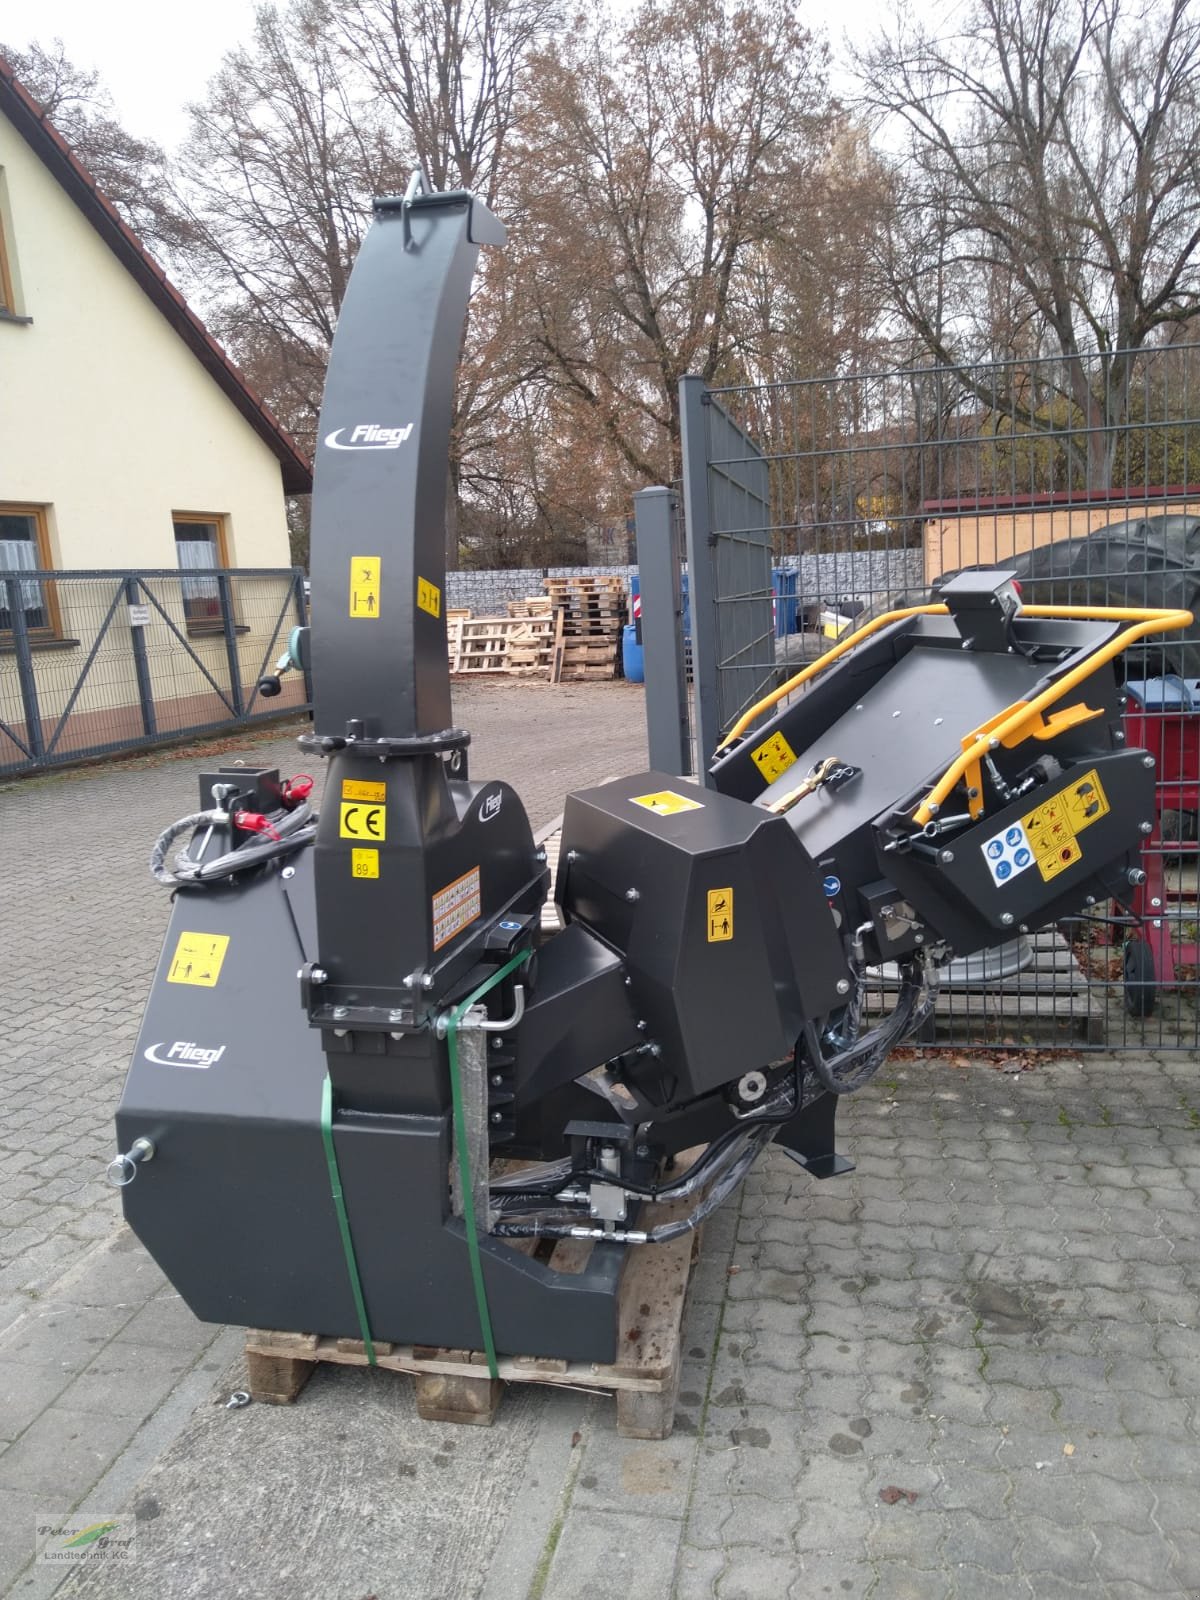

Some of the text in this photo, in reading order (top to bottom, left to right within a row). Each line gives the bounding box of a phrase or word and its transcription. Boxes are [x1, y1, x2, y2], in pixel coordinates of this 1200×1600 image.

[350, 422, 414, 447] Fliegl
[485, 788, 503, 815] Fliegl
[344, 807, 381, 837] CE
[356, 863, 369, 876] 89
[167, 1041, 226, 1066] Fliegl
